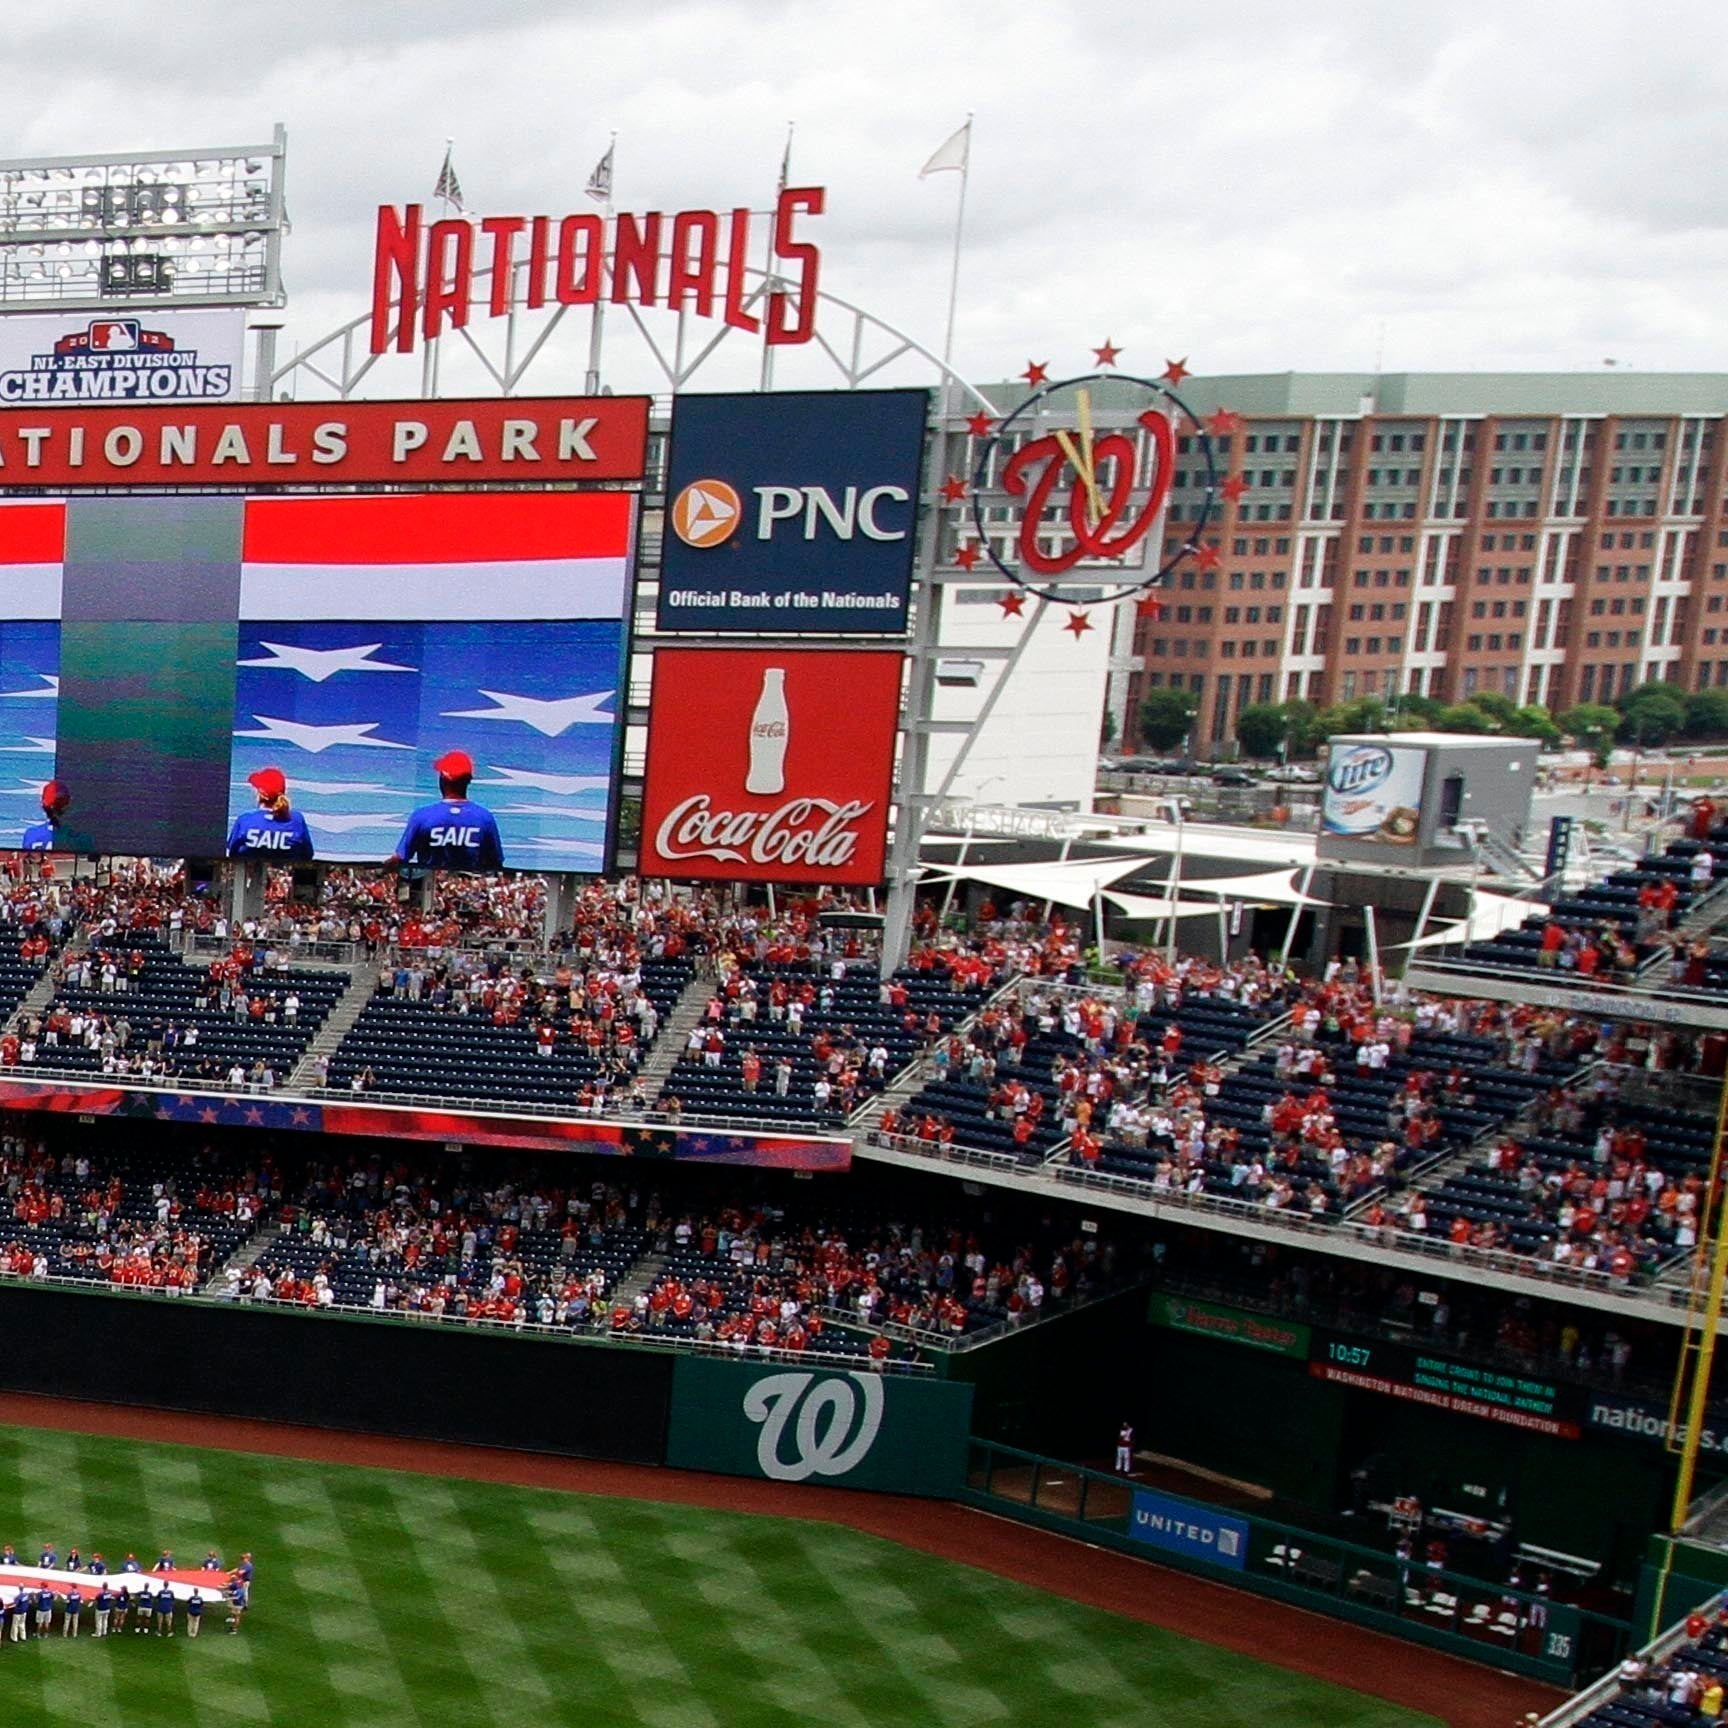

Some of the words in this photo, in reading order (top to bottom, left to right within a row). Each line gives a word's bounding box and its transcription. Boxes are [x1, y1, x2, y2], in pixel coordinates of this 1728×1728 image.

[370, 186, 825, 354] NATIONALS
[113, 352, 195, 368] DIVISION
[393, 417, 601, 463] PARK
[752, 485, 910, 542] PNC
[668, 589, 726, 608] Official
[730, 591, 770, 608] Bank
[774, 591, 791, 608] of
[794, 592, 818, 608] the
[822, 593, 900, 610] Nationals
[244, 829, 293, 850] SAIC
[429, 826, 481, 848] SAIC
[655, 794, 875, 866] Coca-Cola
[1328, 1343, 1370, 1366] 10:57
[1327, 1368, 1392, 1394] WASHINGTON
[1394, 1384, 1450, 1408] NATIONALS
[1492, 1407, 1560, 1434] FOUNDATION
[743, 1371, 885, 1481] W
[1592, 1404, 1728, 1453] nationas.
[1136, 1510, 1214, 1544] UNITED
